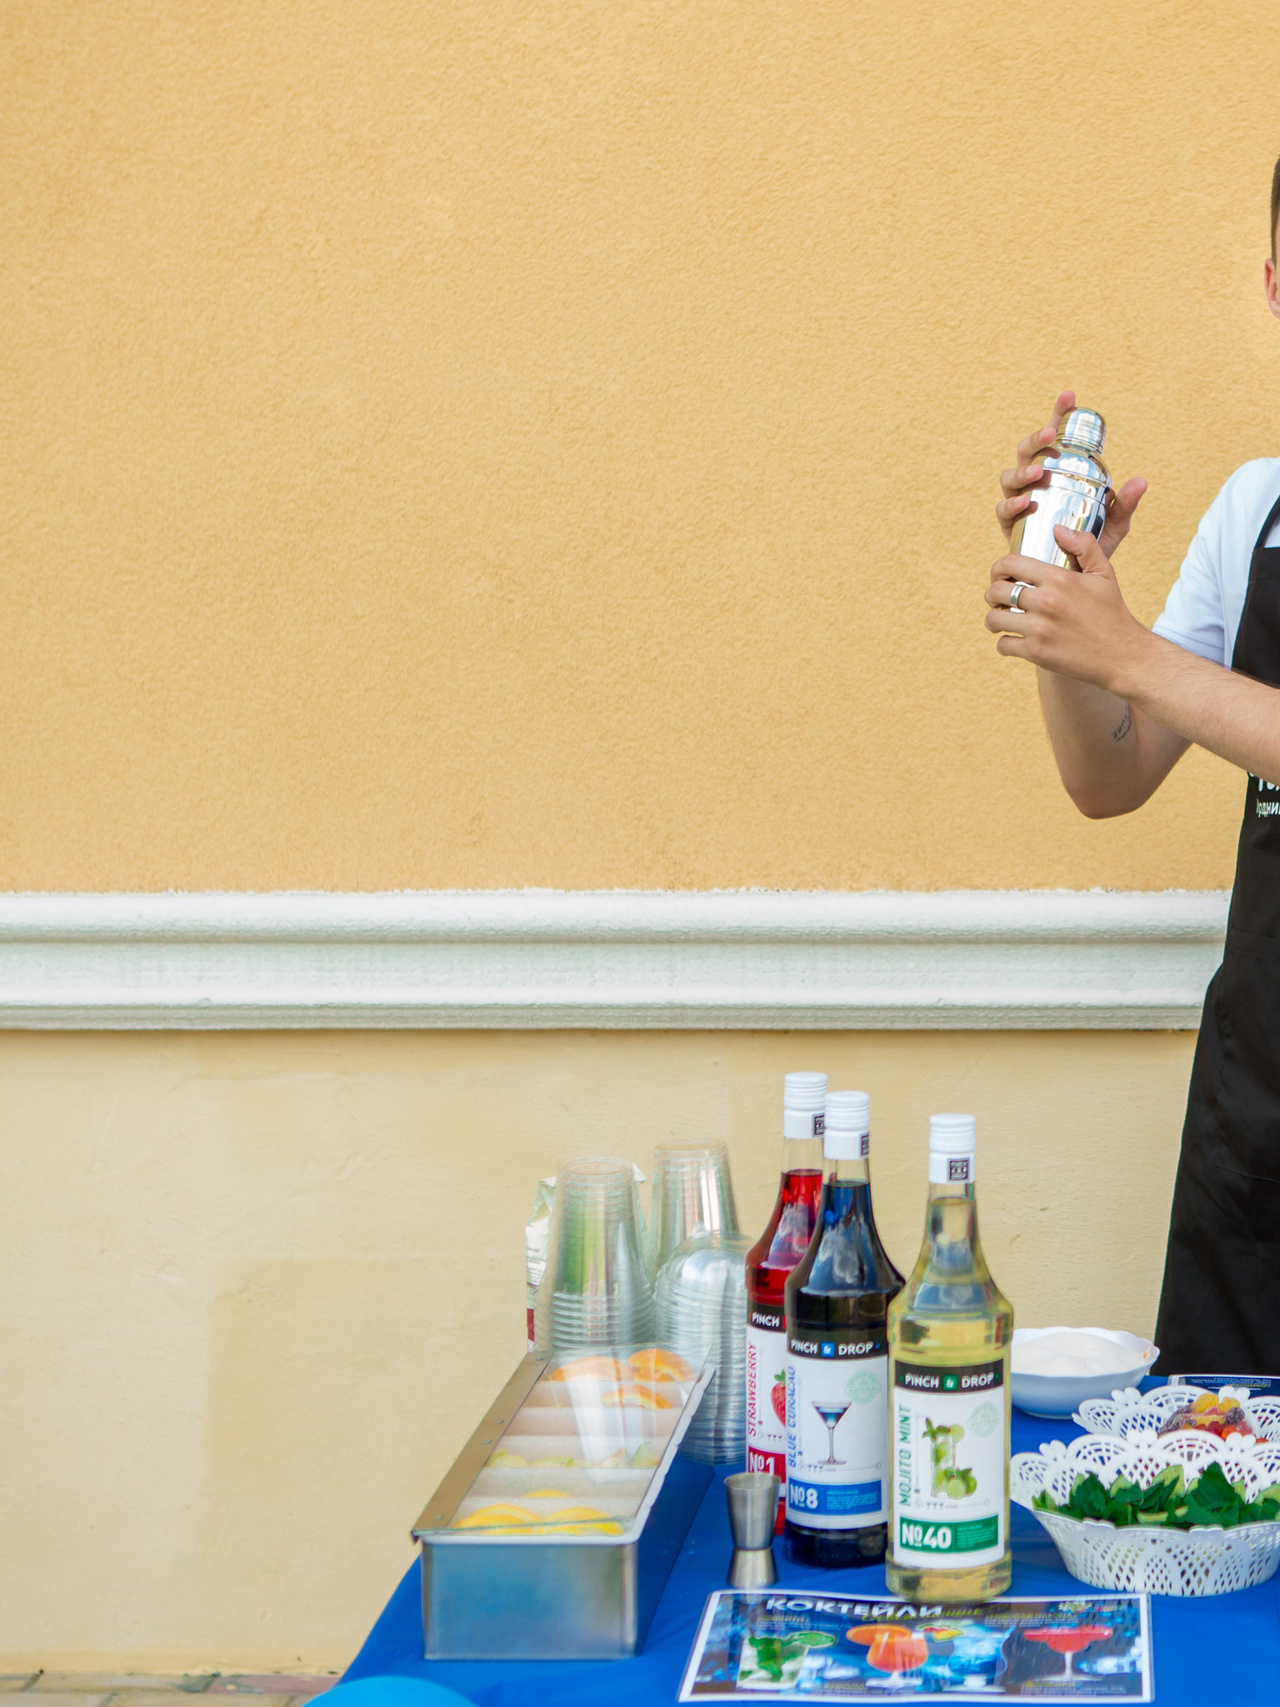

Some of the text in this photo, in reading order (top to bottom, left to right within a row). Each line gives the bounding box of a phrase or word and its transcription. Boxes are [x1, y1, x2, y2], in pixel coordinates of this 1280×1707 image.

[751, 1311, 780, 1328] PINCH
[790, 1338, 819, 1355] PINCH
[838, 1341, 874, 1356] DROP
[747, 1343, 757, 1437] STRAWBERRY
[904, 1372, 940, 1389] PINCH
[961, 1371, 995, 1389] DROP
[787, 1433, 797, 1468] BLUE
[898, 1404, 912, 1507] MOJITO MINT
[765, 1597, 943, 1617] КОКТЕЙЛИ
